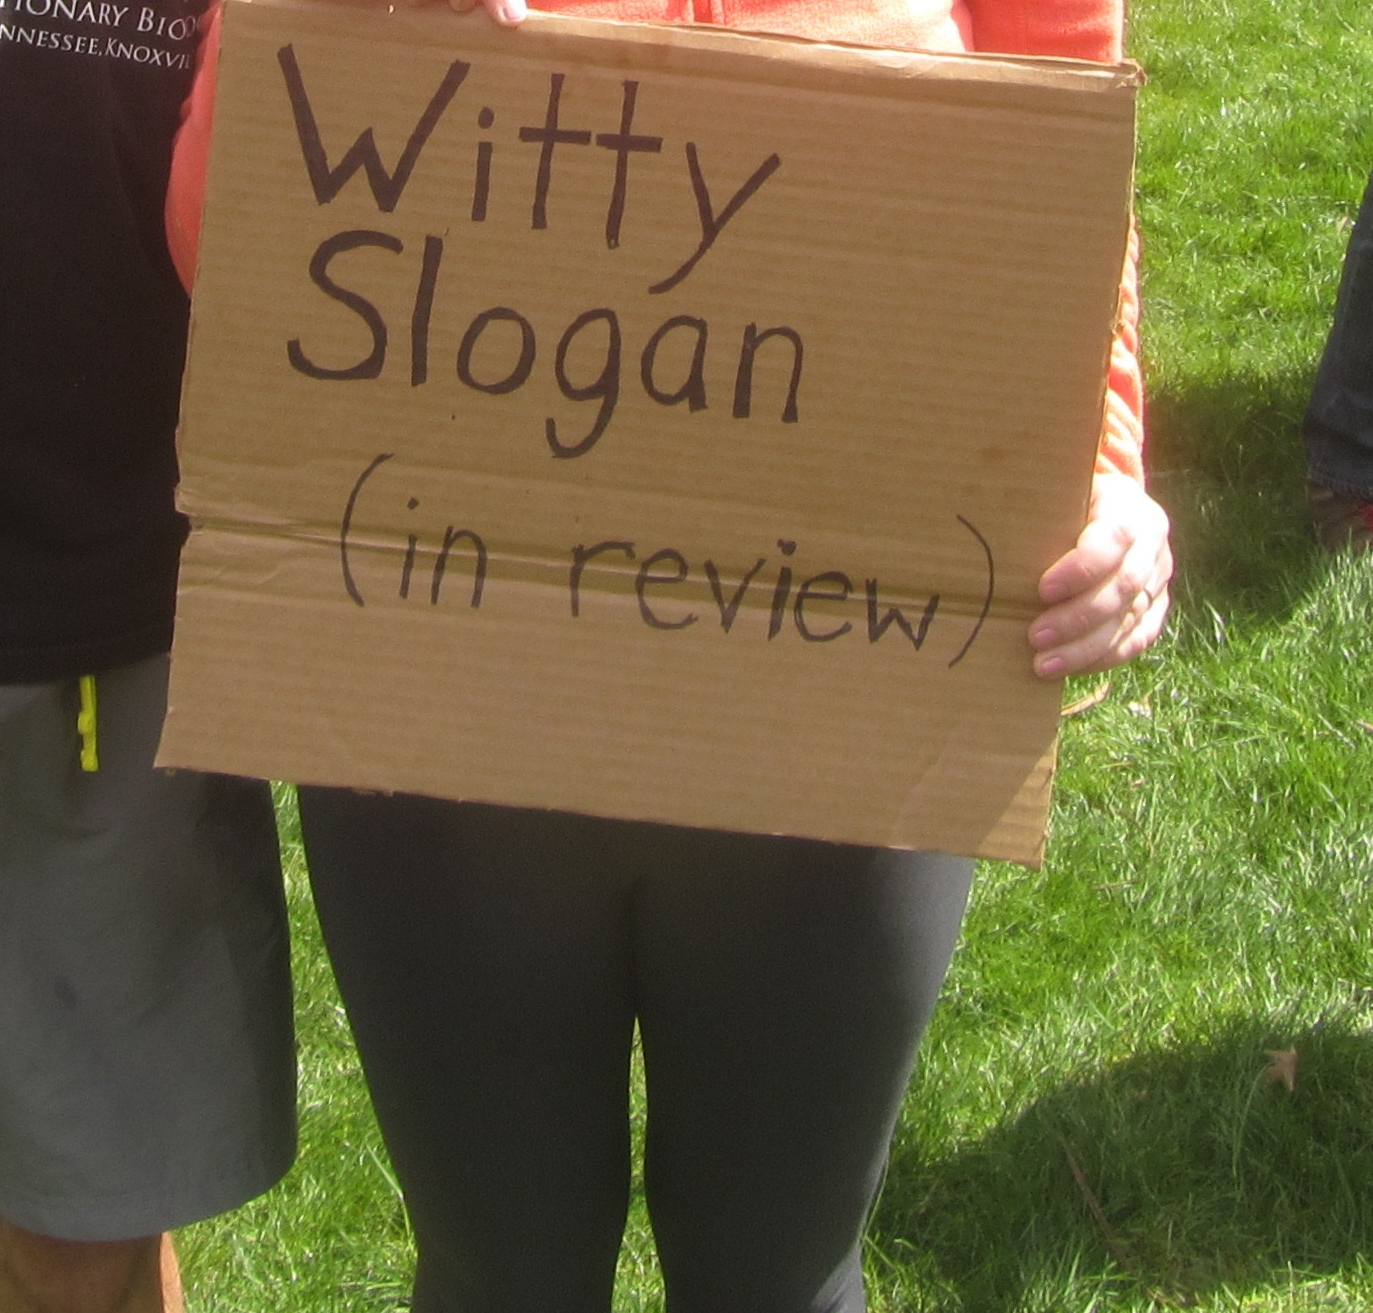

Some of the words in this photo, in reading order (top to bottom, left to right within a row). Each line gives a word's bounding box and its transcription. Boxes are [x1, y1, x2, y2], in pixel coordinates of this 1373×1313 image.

[275, 42, 782, 296] Witty
[286, 230, 805, 461] Slogan
[339, 452, 488, 609] (in
[570, 513, 996, 669] review)
